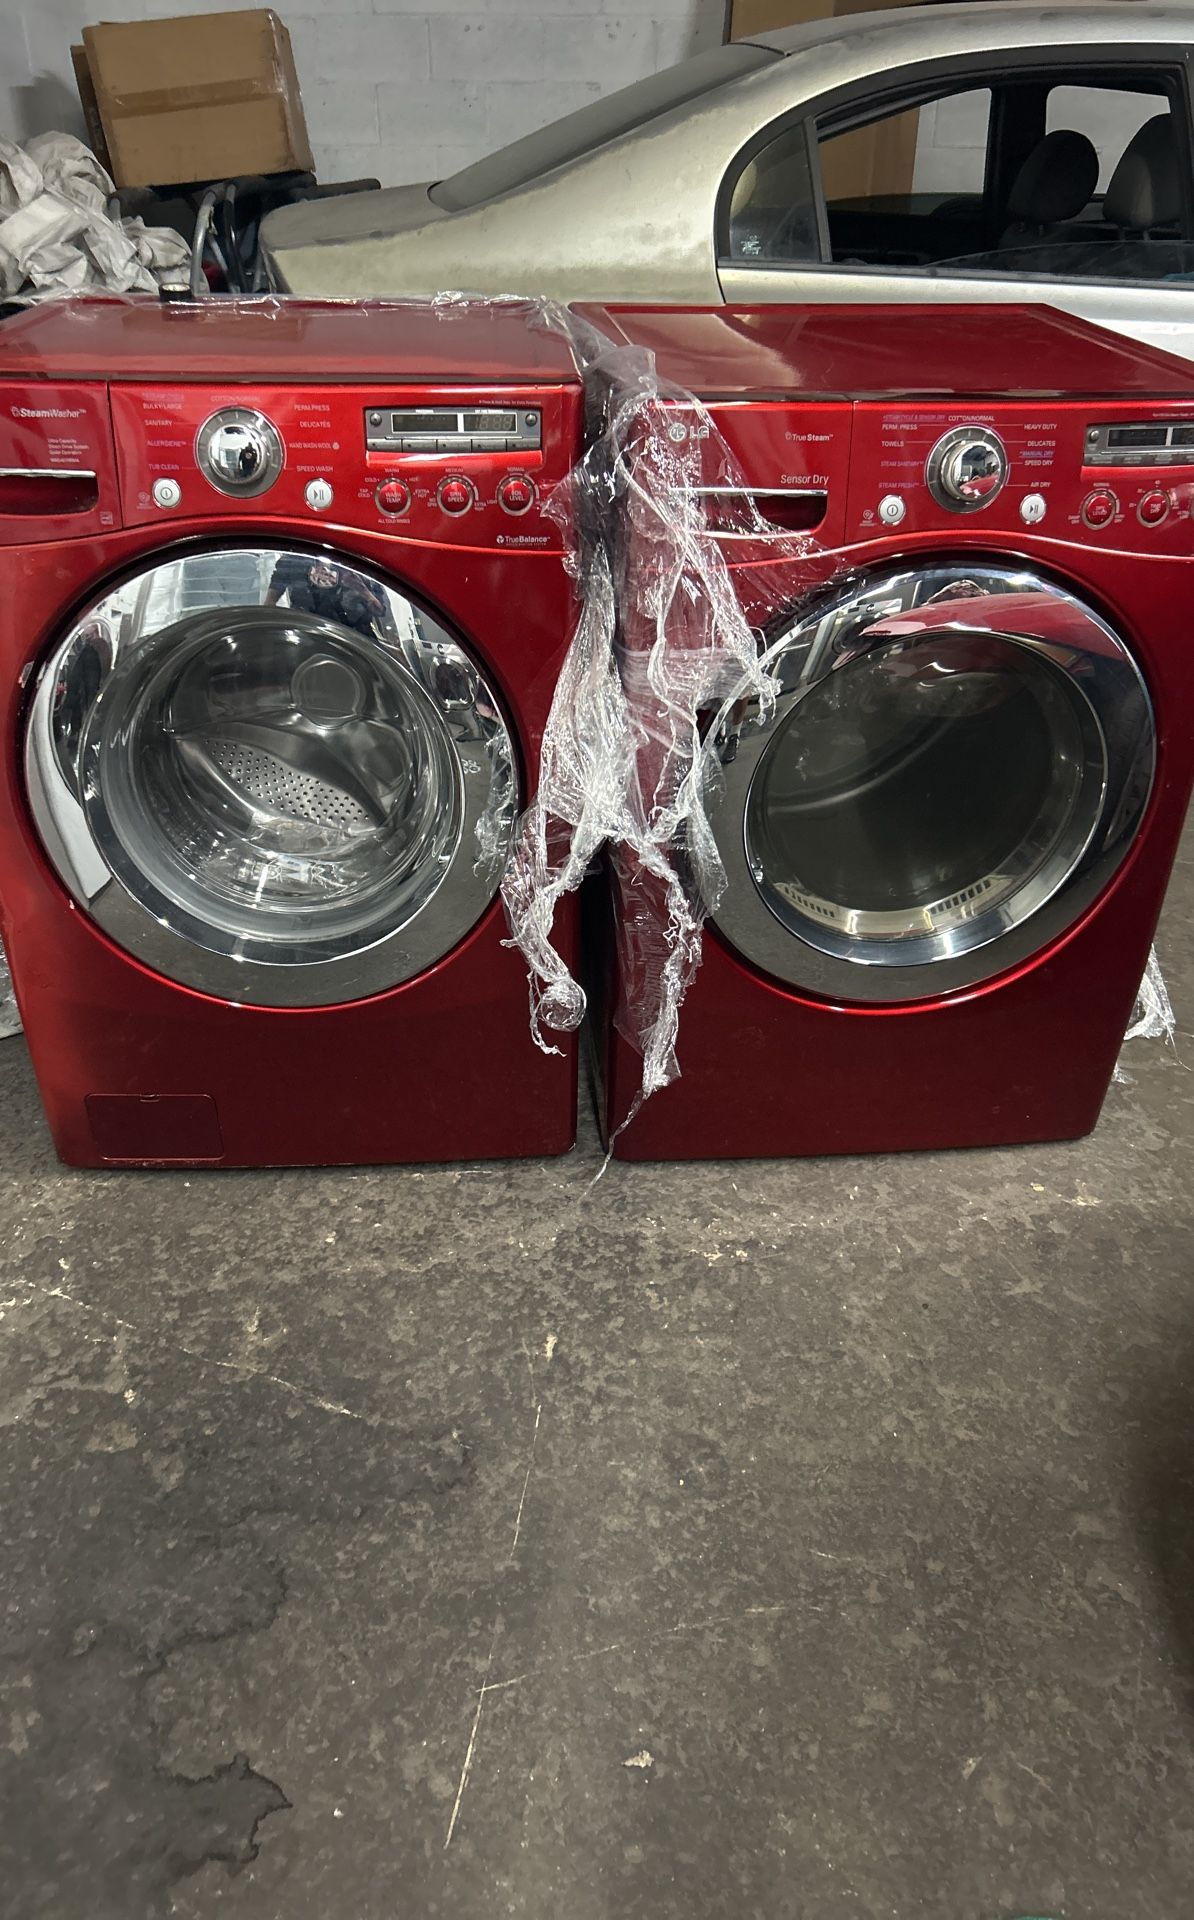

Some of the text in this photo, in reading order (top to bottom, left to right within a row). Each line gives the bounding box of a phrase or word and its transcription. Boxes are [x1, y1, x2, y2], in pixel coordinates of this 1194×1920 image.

[690, 425, 709, 439] LG
[296, 465, 334, 473] SPEED WASH
[780, 474, 829, 486] Sensor Dry
